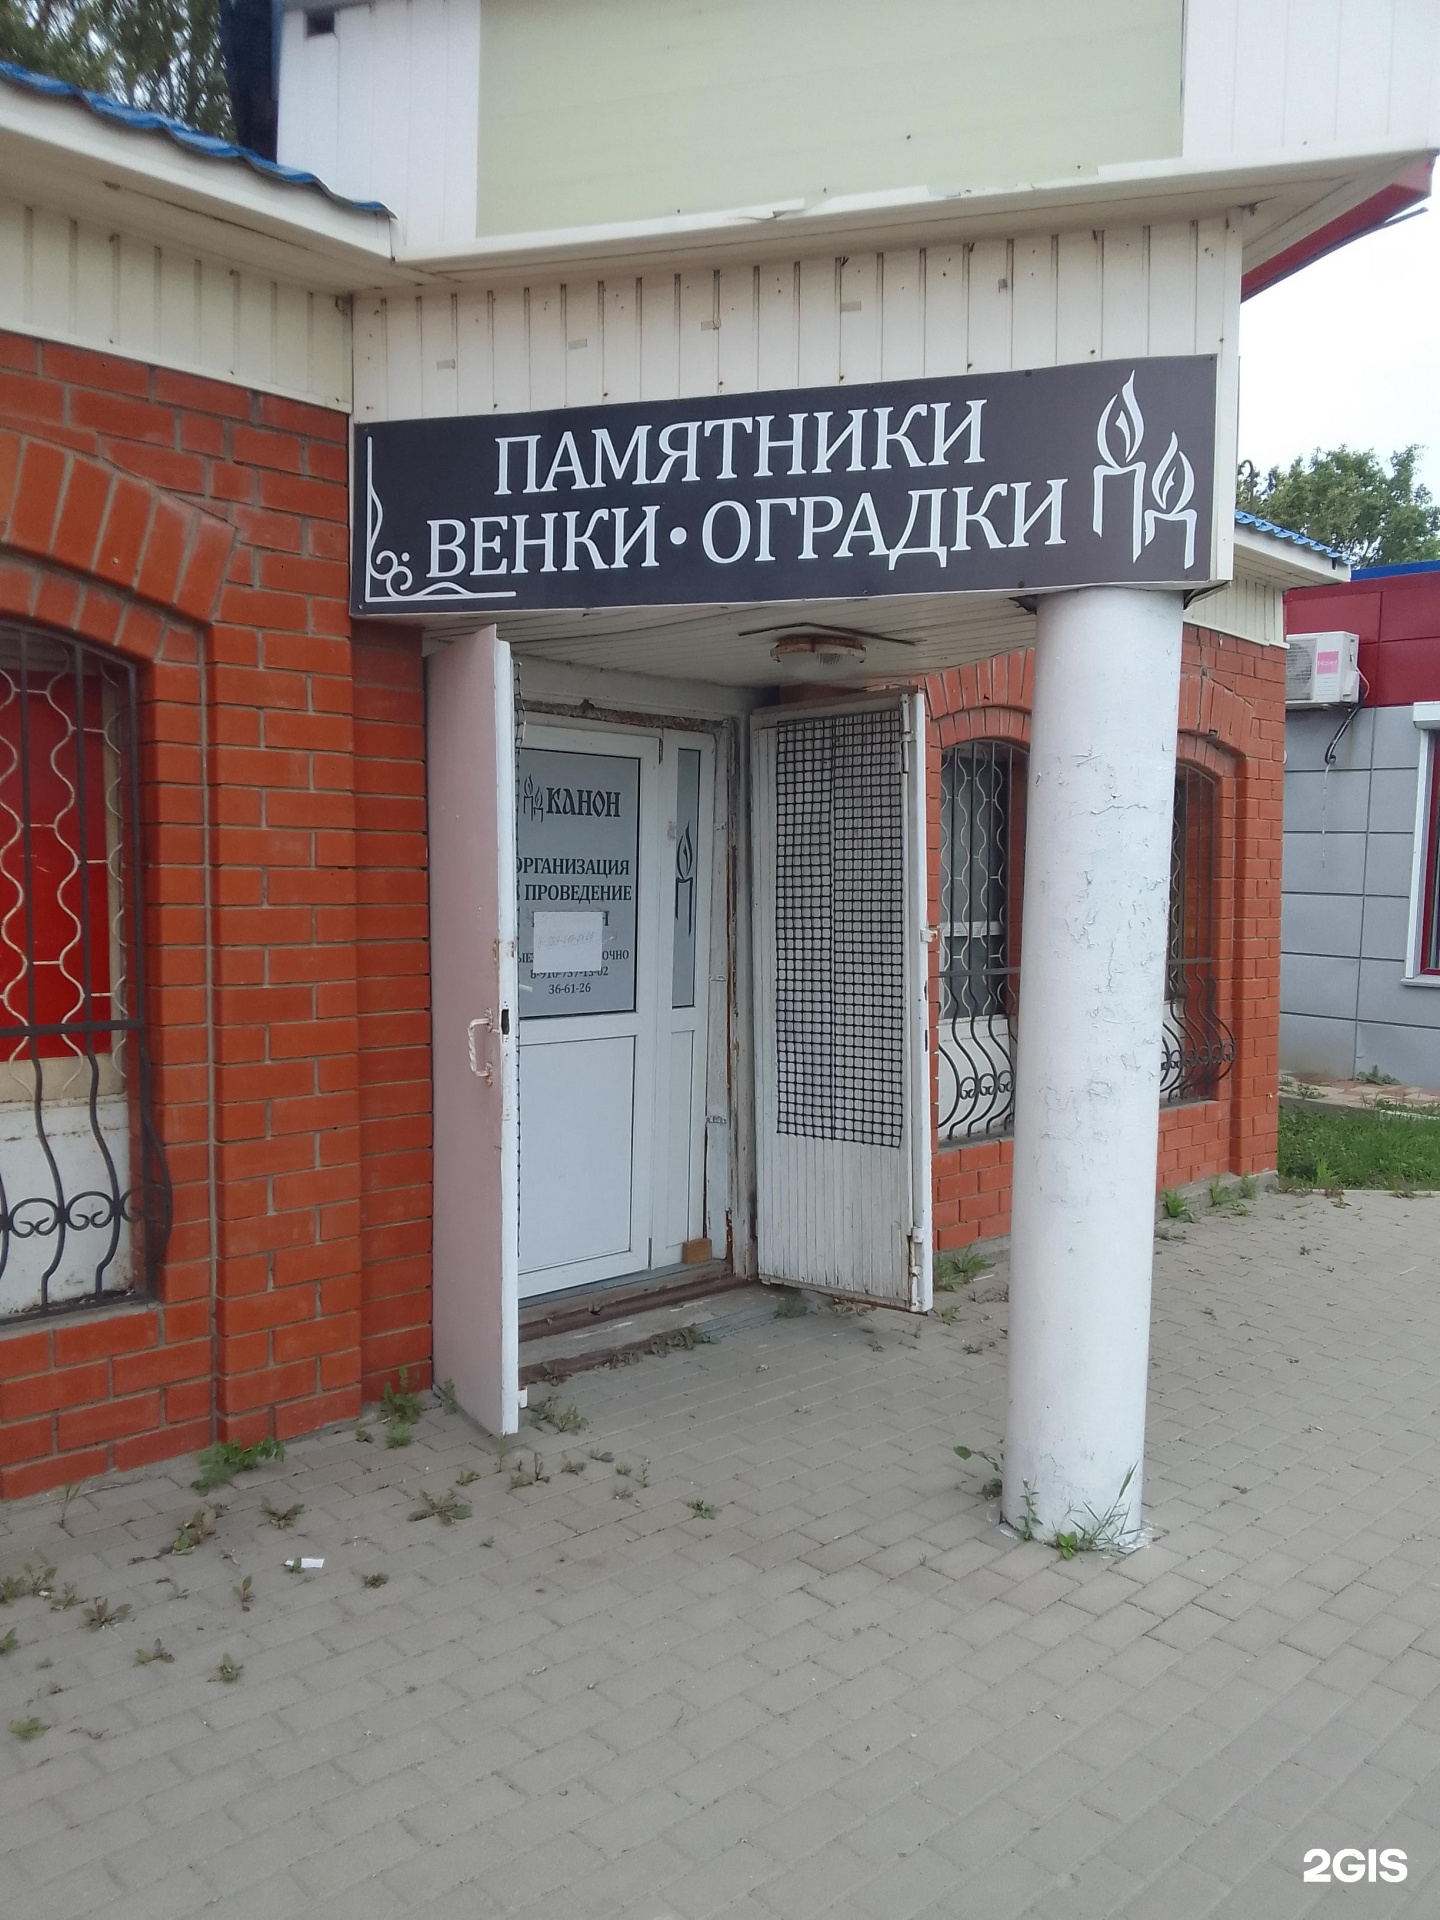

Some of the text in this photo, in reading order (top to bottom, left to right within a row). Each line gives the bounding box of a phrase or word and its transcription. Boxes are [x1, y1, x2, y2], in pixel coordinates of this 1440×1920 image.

[494, 399, 988, 496] ПАМЯТНИКИ
[426, 478, 1069, 578] ВЕНКИ ОГРАДКИ
[545, 787, 621, 818] КАНОН
[524, 884, 632, 905] ПРОВЕДЕНИЕ
[548, 982, 592, 995] 36-61-26
